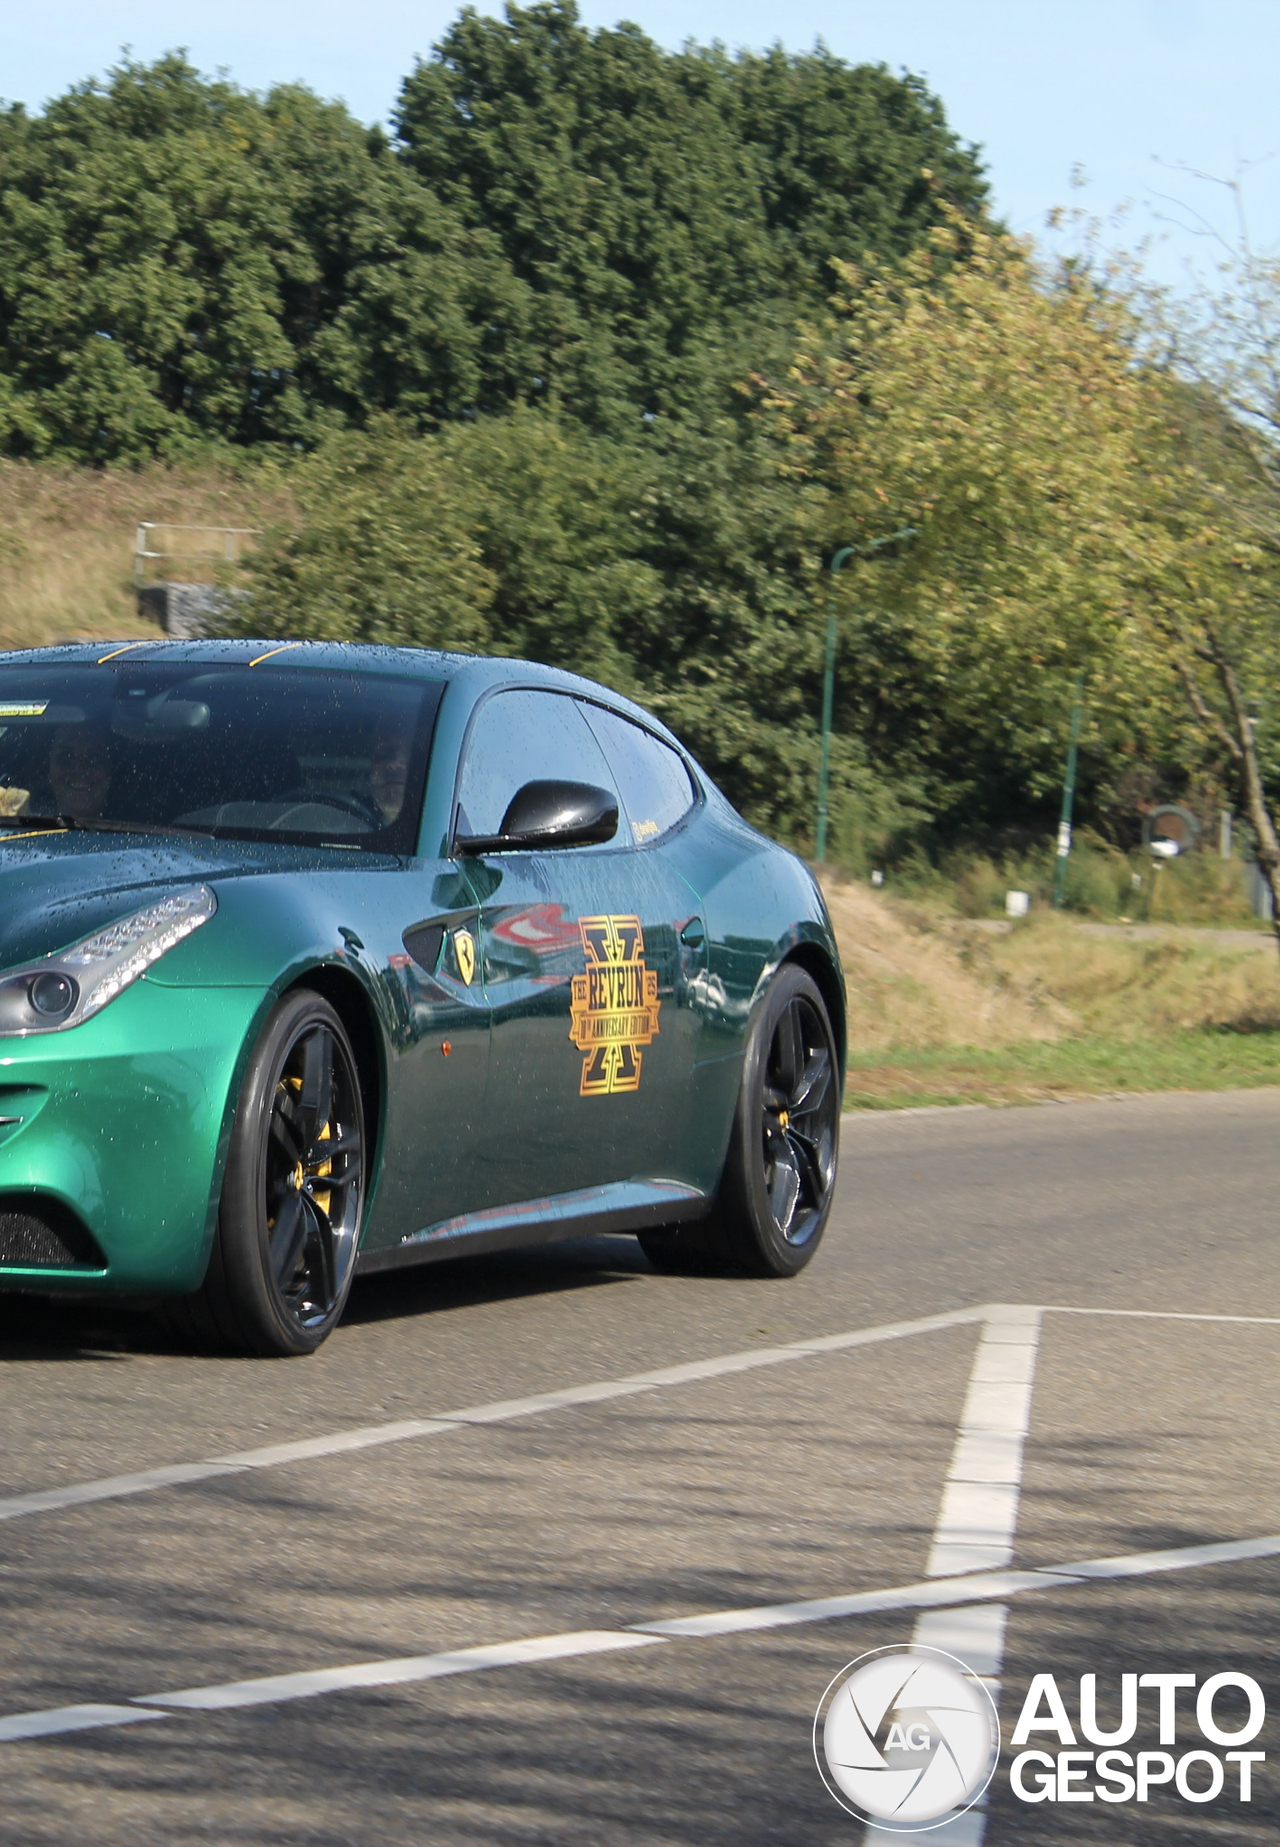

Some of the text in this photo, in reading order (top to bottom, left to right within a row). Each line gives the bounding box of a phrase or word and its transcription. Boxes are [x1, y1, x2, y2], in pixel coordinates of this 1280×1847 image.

[573, 980, 587, 1001] THE
[588, 965, 644, 1010] REVRUN
[592, 1015, 629, 1038] ANNIVERSARY
